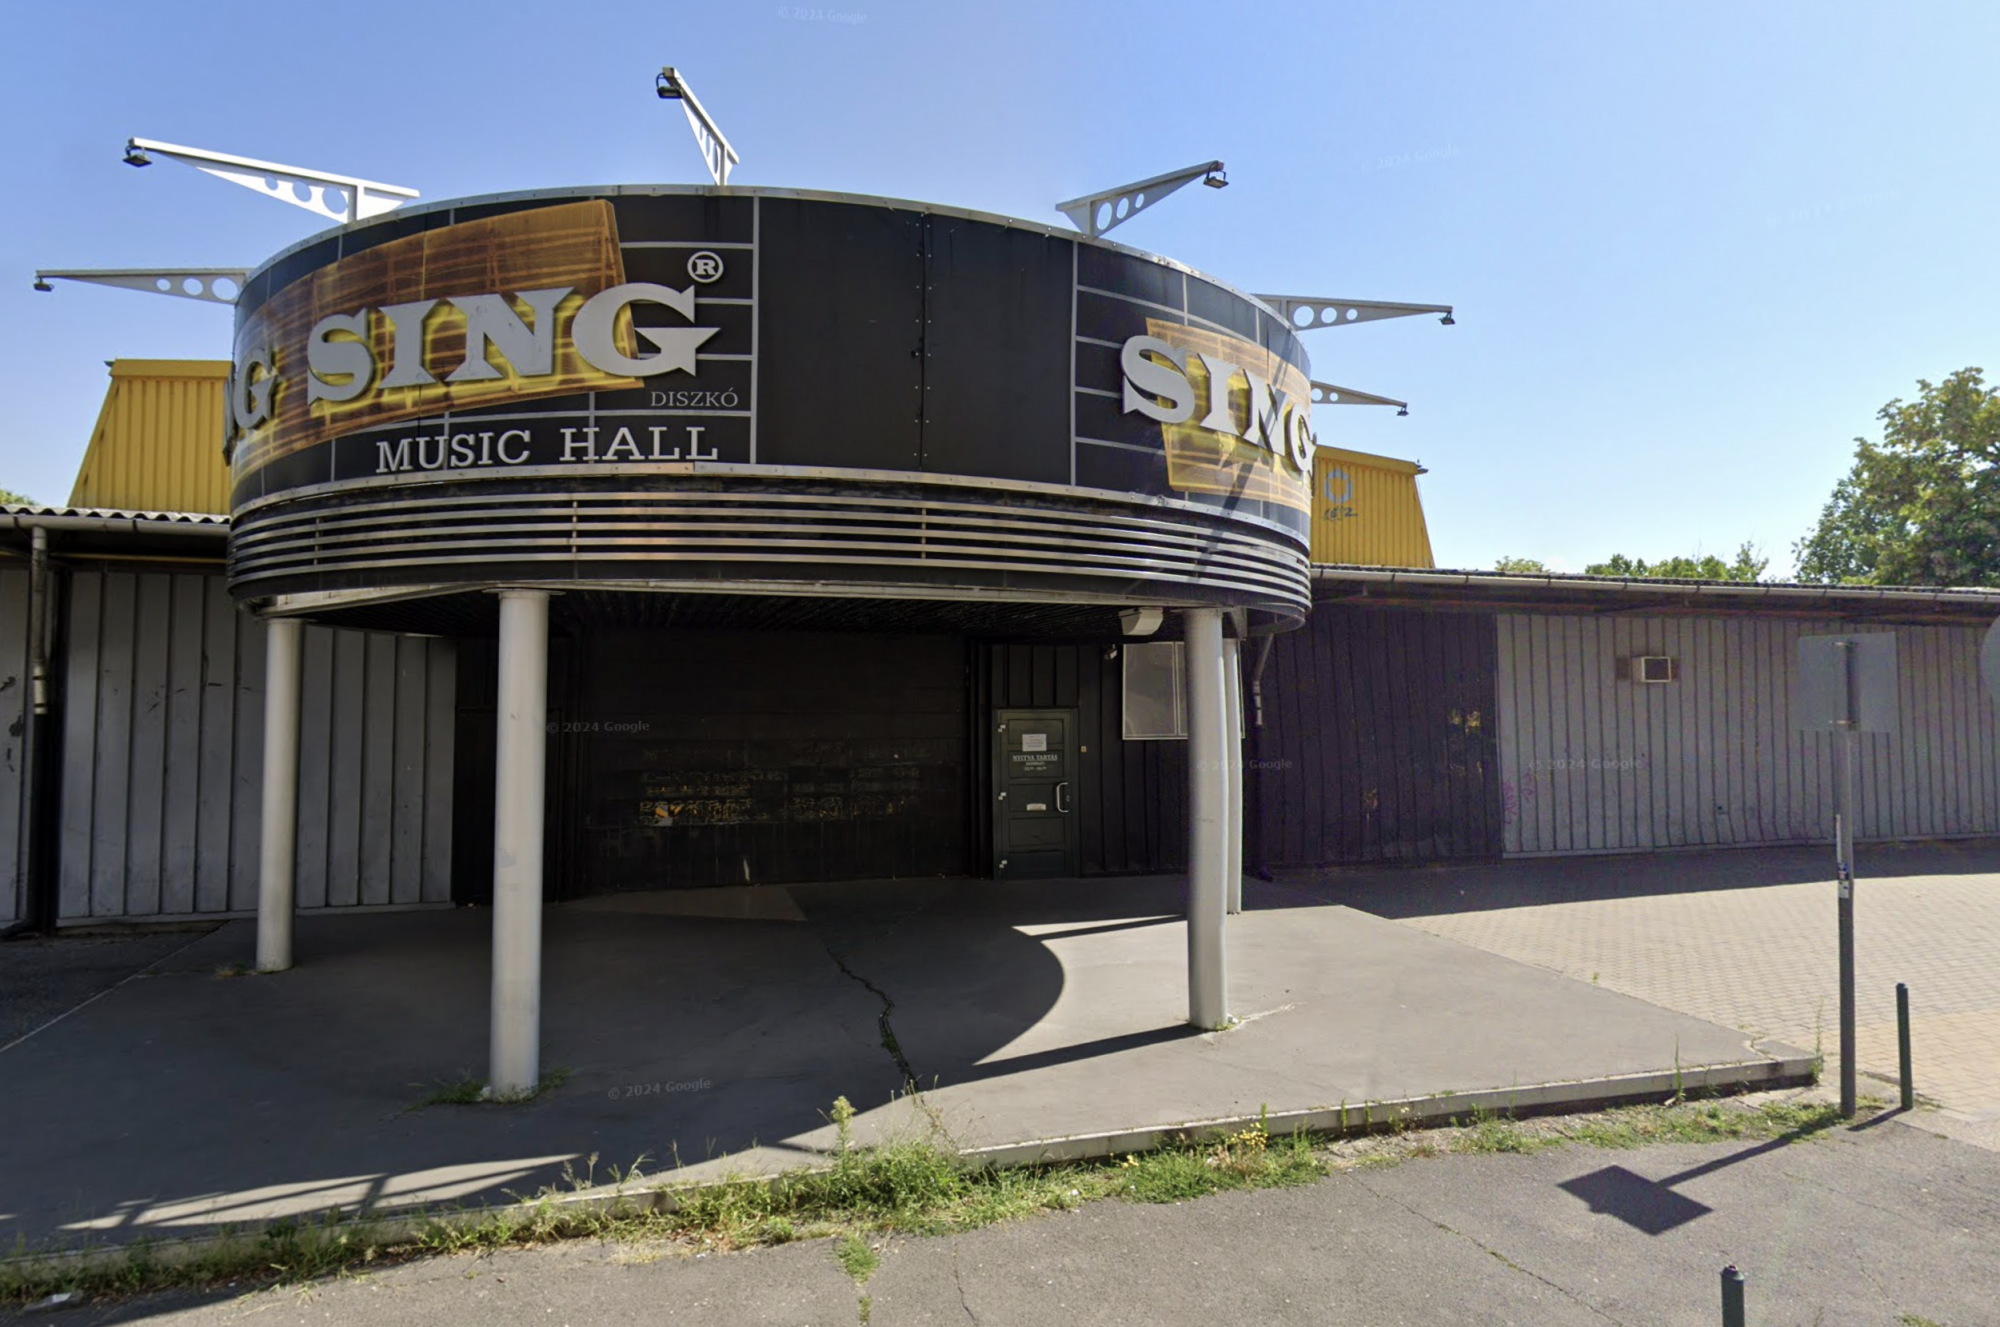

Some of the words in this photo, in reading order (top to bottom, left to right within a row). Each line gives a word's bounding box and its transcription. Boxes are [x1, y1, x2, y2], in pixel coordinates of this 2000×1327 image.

[307, 282, 721, 405] SING
[650, 387, 738, 408] DISZKÓ
[1120, 334, 1317, 477] SING
[375, 429, 531, 473] MUSIC
[559, 426, 718, 462] HALL
[1036, 754, 1058, 762] TARTÁS
